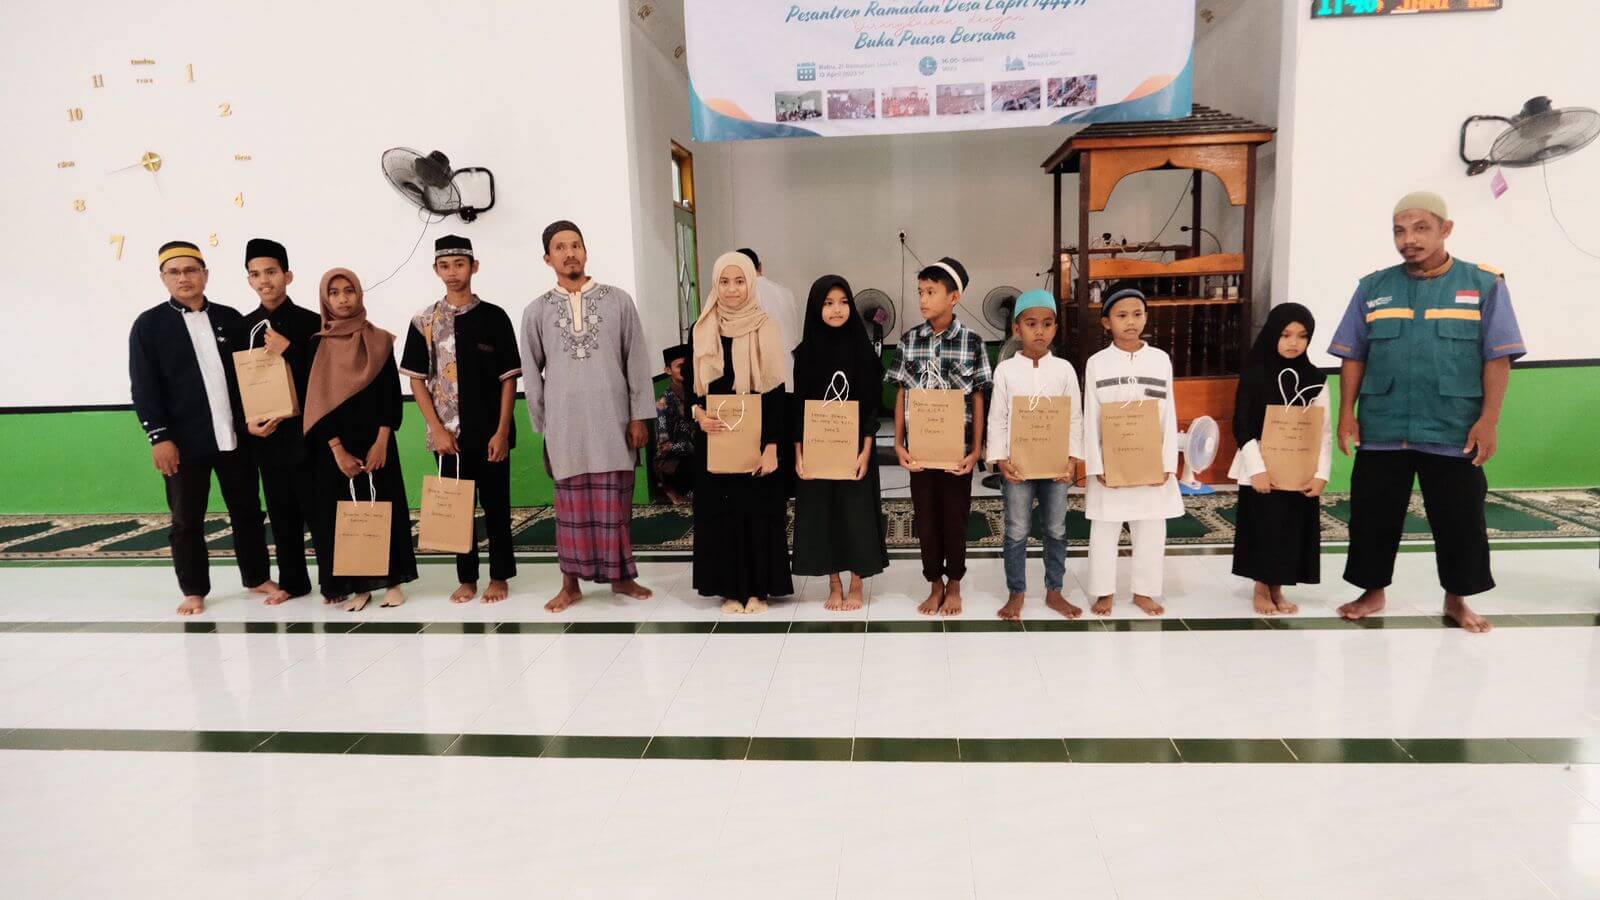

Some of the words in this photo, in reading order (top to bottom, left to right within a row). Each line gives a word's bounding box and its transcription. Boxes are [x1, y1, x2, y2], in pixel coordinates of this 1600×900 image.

[785, 5, 861, 22] Pesantren
[864, 1, 940, 17] Ramadan
[943, 0, 981, 12] Desa
[854, 32, 895, 49] Buka
[898, 29, 945, 46] Puasa
[950, 26, 1016, 44] Bersama
[93, 74, 105, 89] 11
[67, 108, 83, 122] 10
[219, 103, 233, 118] 2
[74, 199, 87, 213] 8
[235, 192, 245, 208] 4
[109, 234, 125, 261] 7
